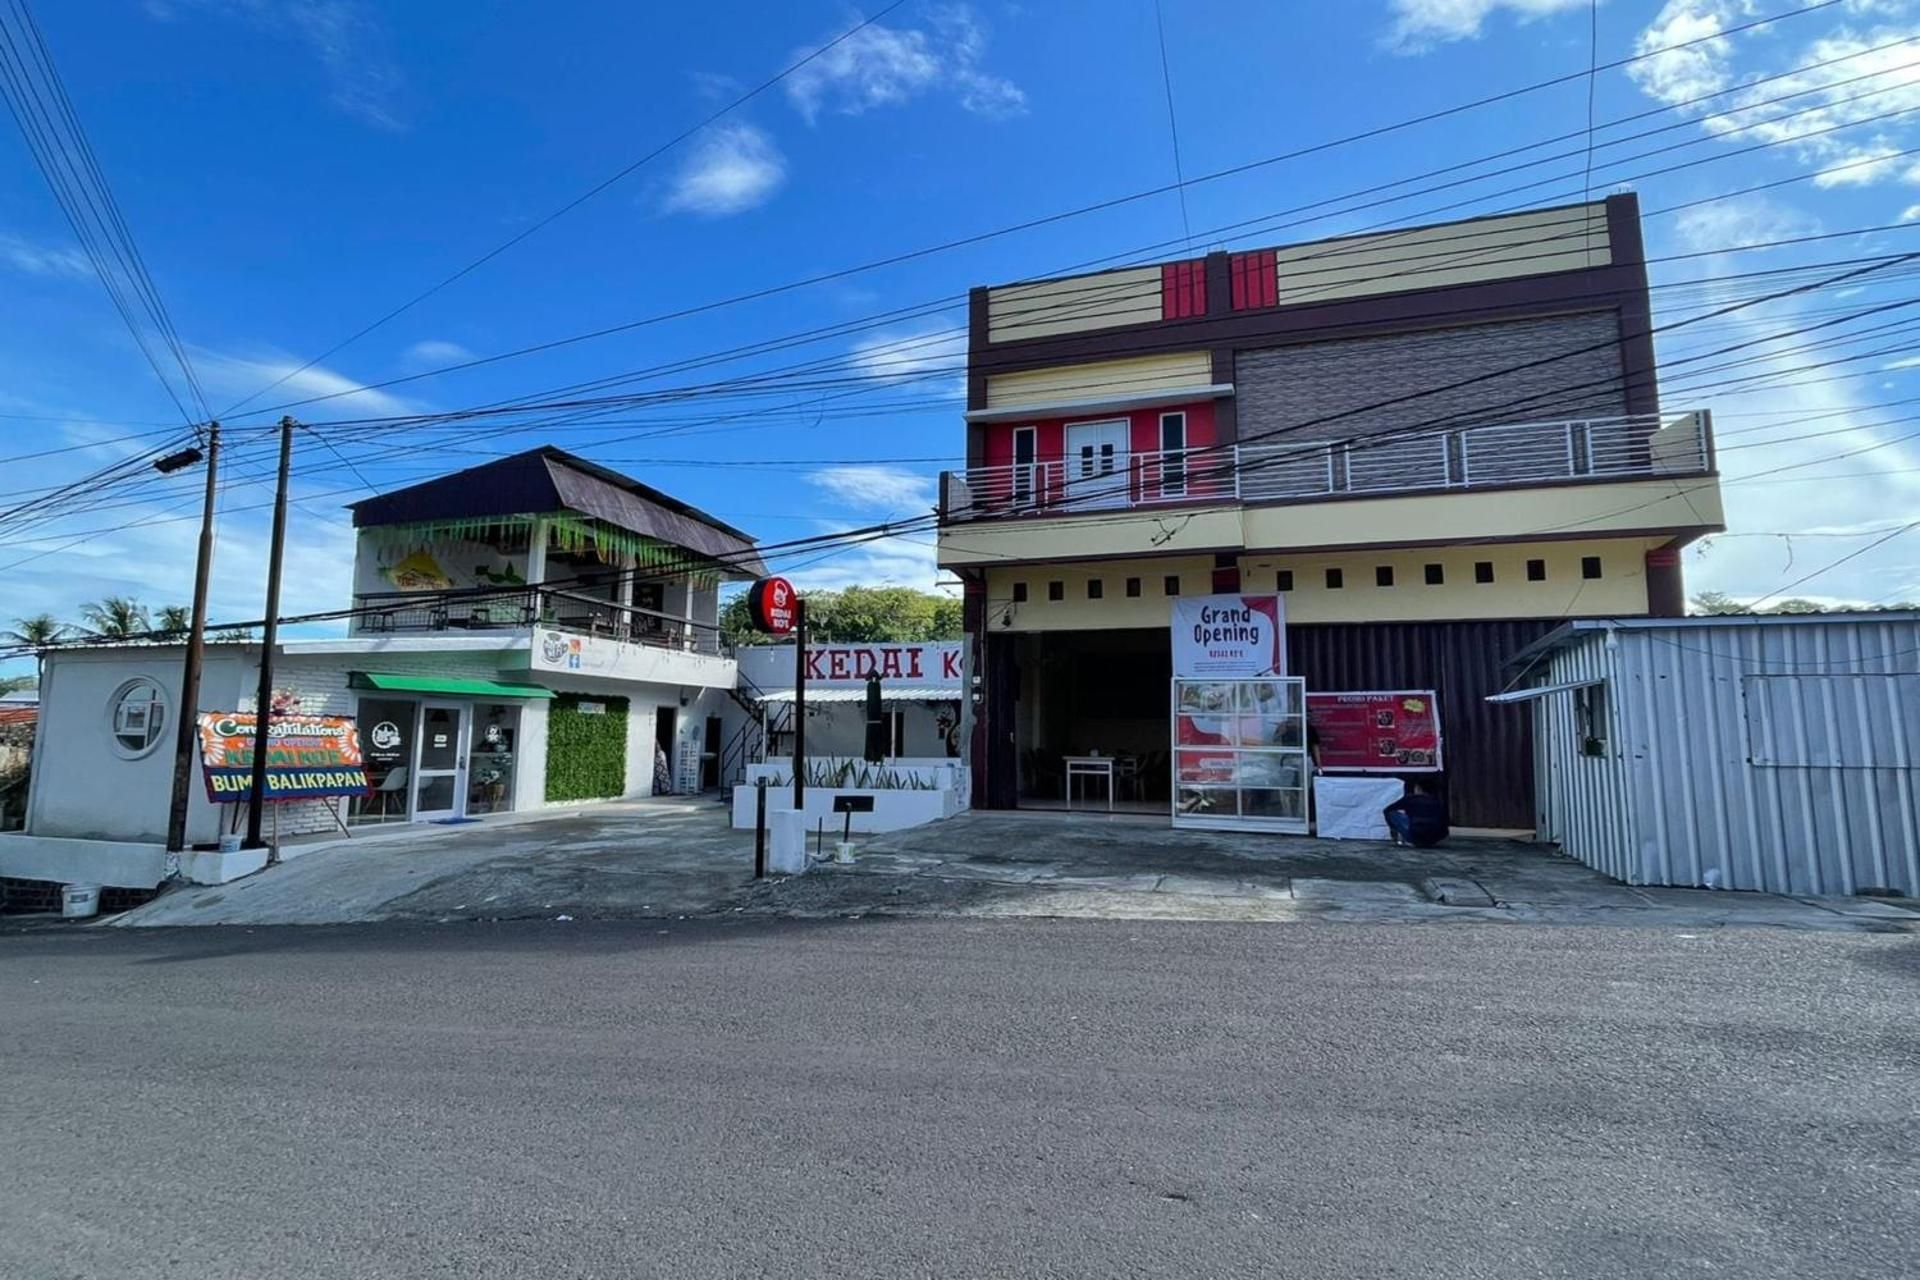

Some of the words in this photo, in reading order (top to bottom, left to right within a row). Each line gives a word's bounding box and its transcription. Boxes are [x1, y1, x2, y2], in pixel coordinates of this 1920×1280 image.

[1201, 605, 1251, 624] Grand
[1194, 624, 1259, 647] Opening
[804, 648, 923, 680] KEDAI
[943, 651, 965, 679] K
[267, 772, 367, 791] BALIKPAPAN
